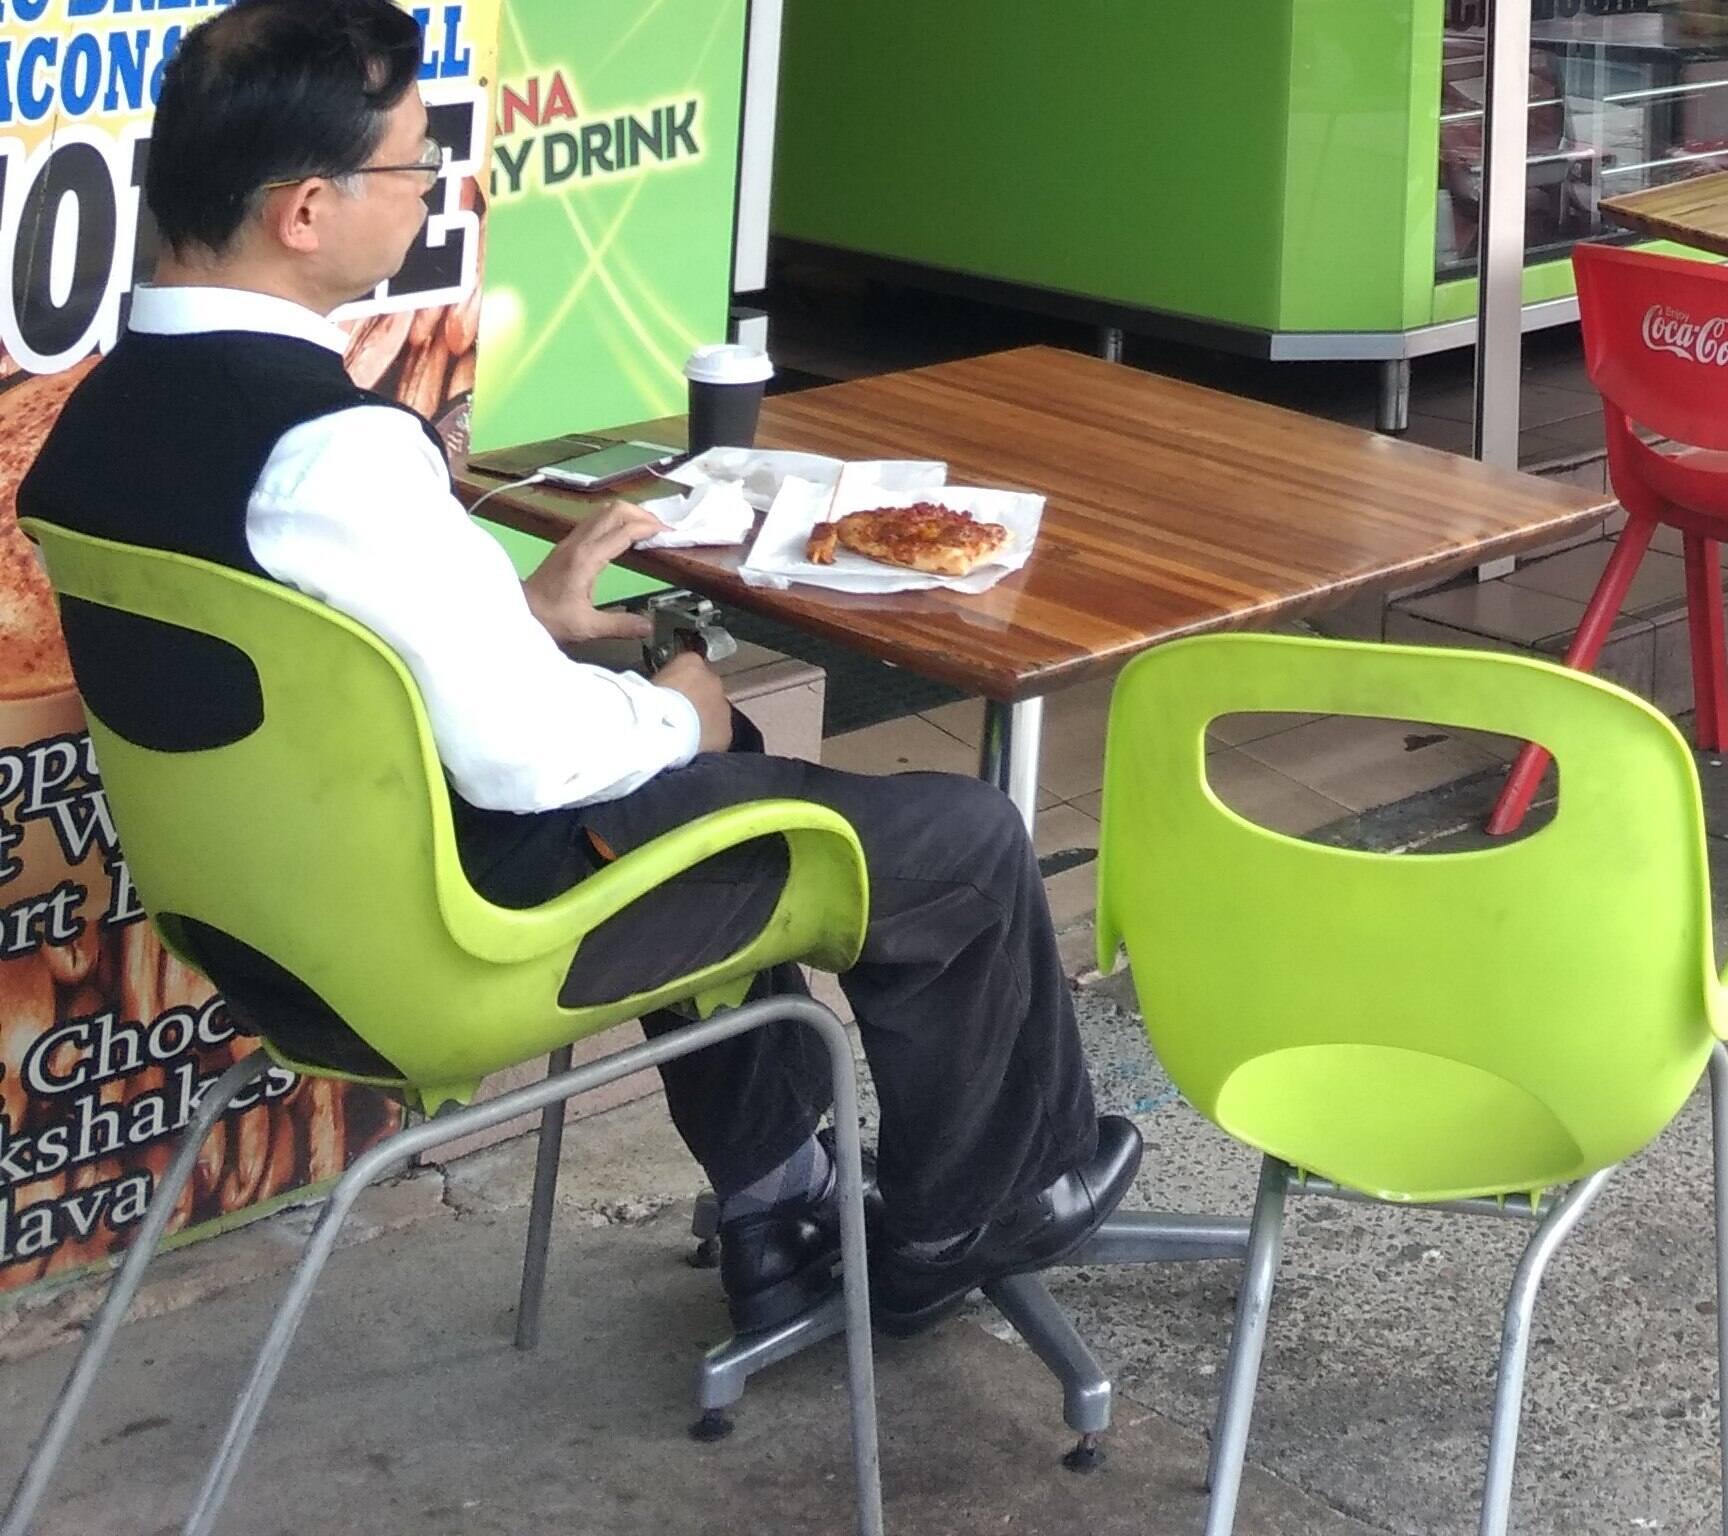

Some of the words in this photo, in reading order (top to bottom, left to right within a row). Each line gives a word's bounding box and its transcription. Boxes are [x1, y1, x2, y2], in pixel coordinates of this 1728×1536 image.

[495, 70, 577, 135] NA
[490, 137, 535, 196] Y
[543, 101, 699, 185] DRINK
